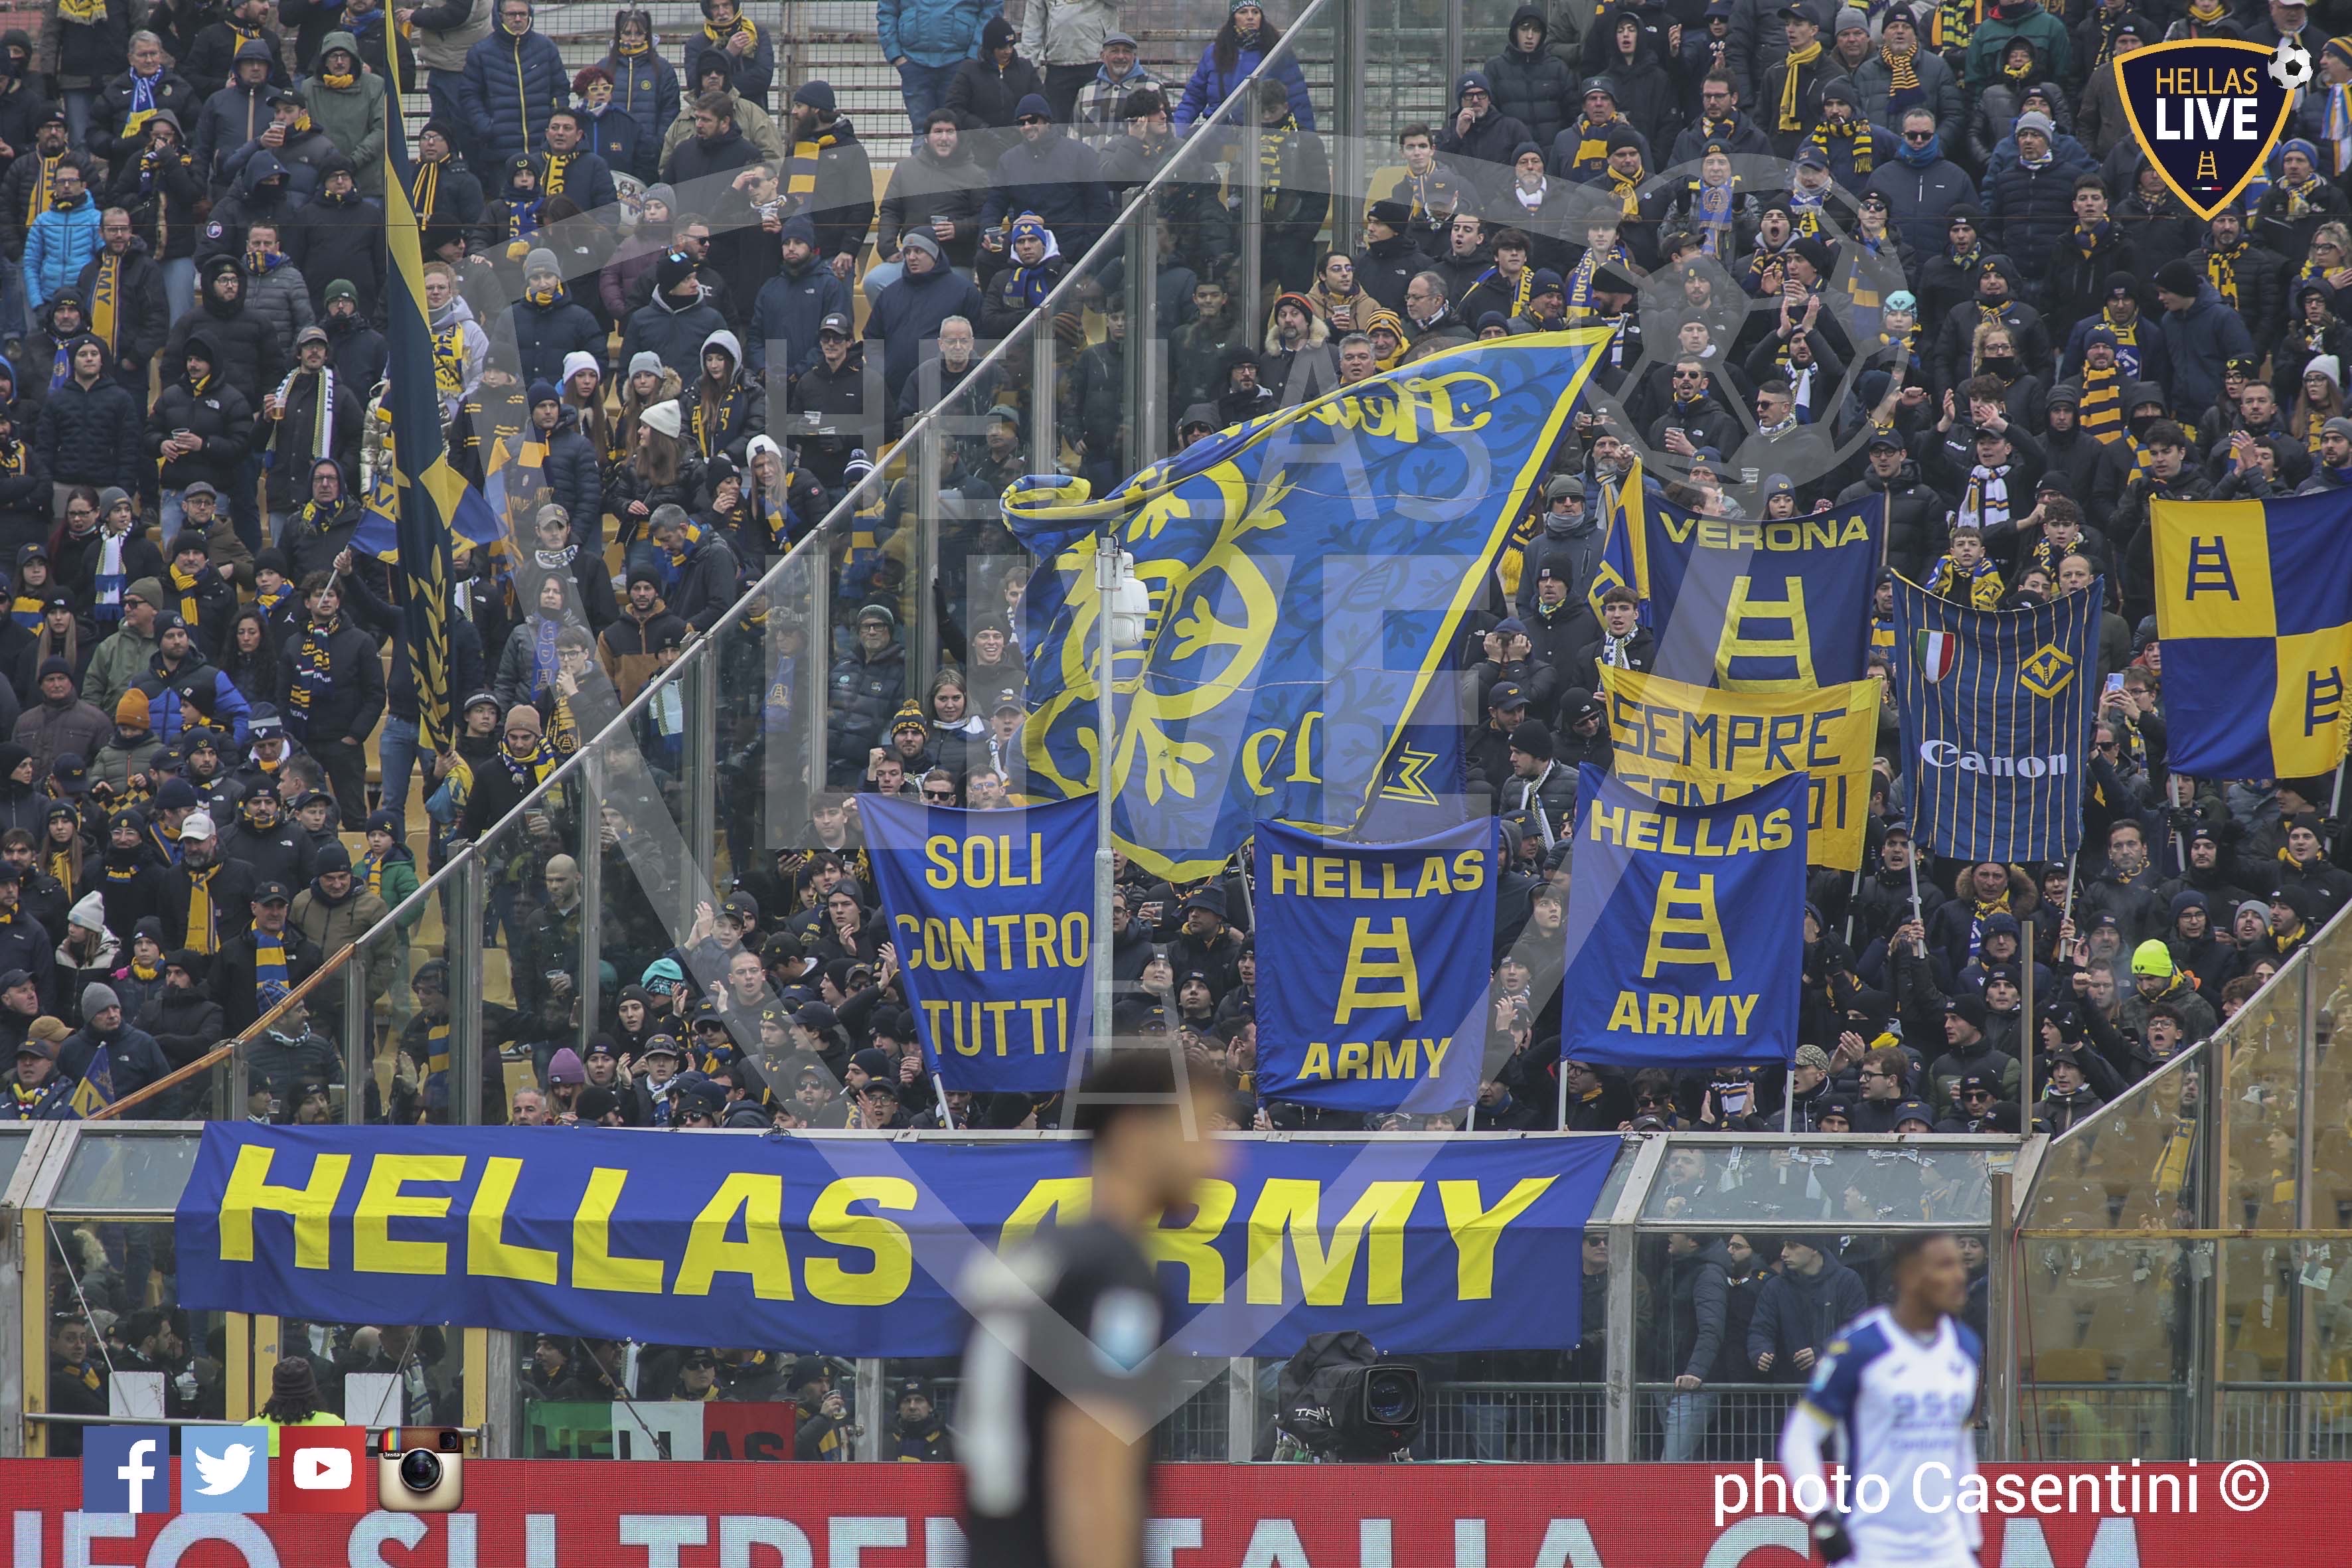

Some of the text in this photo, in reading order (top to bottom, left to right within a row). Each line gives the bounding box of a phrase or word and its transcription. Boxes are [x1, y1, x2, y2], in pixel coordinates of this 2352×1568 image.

[1659, 511, 1870, 552] VERONA
[1613, 693, 1847, 771] SEMPRE
[1920, 740, 2068, 778] Canon
[1590, 799, 1793, 857] HELLAS
[925, 832, 1042, 890] SOLI
[1271, 849, 1485, 900] HELLAS
[896, 911, 1089, 972] CONTRO
[920, 996, 1067, 1057] TUTTI
[1607, 990, 1760, 1036] ARMY
[1295, 1037, 1452, 1080] ARMY
[220, 1143, 918, 1306] HELLAS
